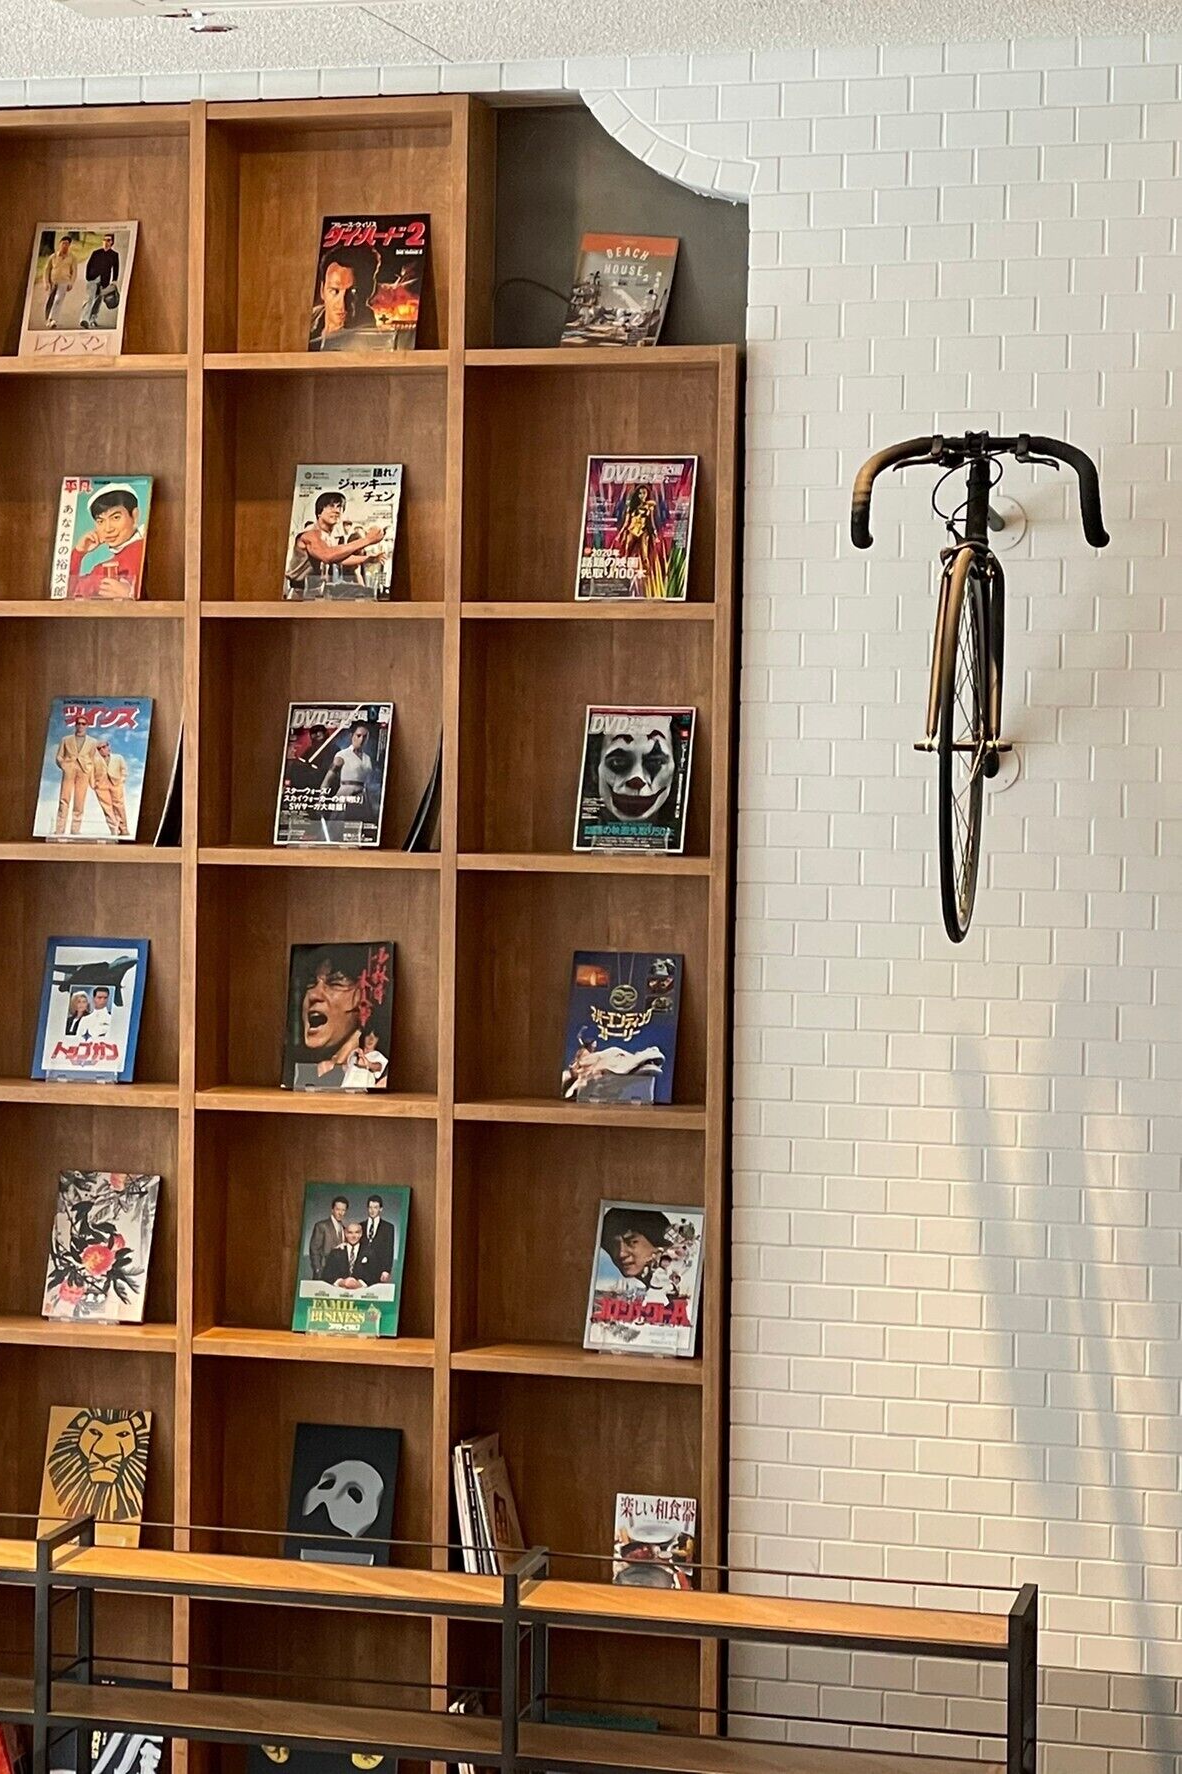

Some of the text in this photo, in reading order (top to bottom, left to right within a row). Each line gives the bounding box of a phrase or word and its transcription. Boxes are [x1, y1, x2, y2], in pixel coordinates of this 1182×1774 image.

[606, 246, 650, 261] BEACH
[603, 263, 644, 276] HOUSE
[363, 491, 395, 502] チェン
[311, 1310, 365, 1324] BUSINESS
[620, 1496, 695, 1522] 楽しい和食器
